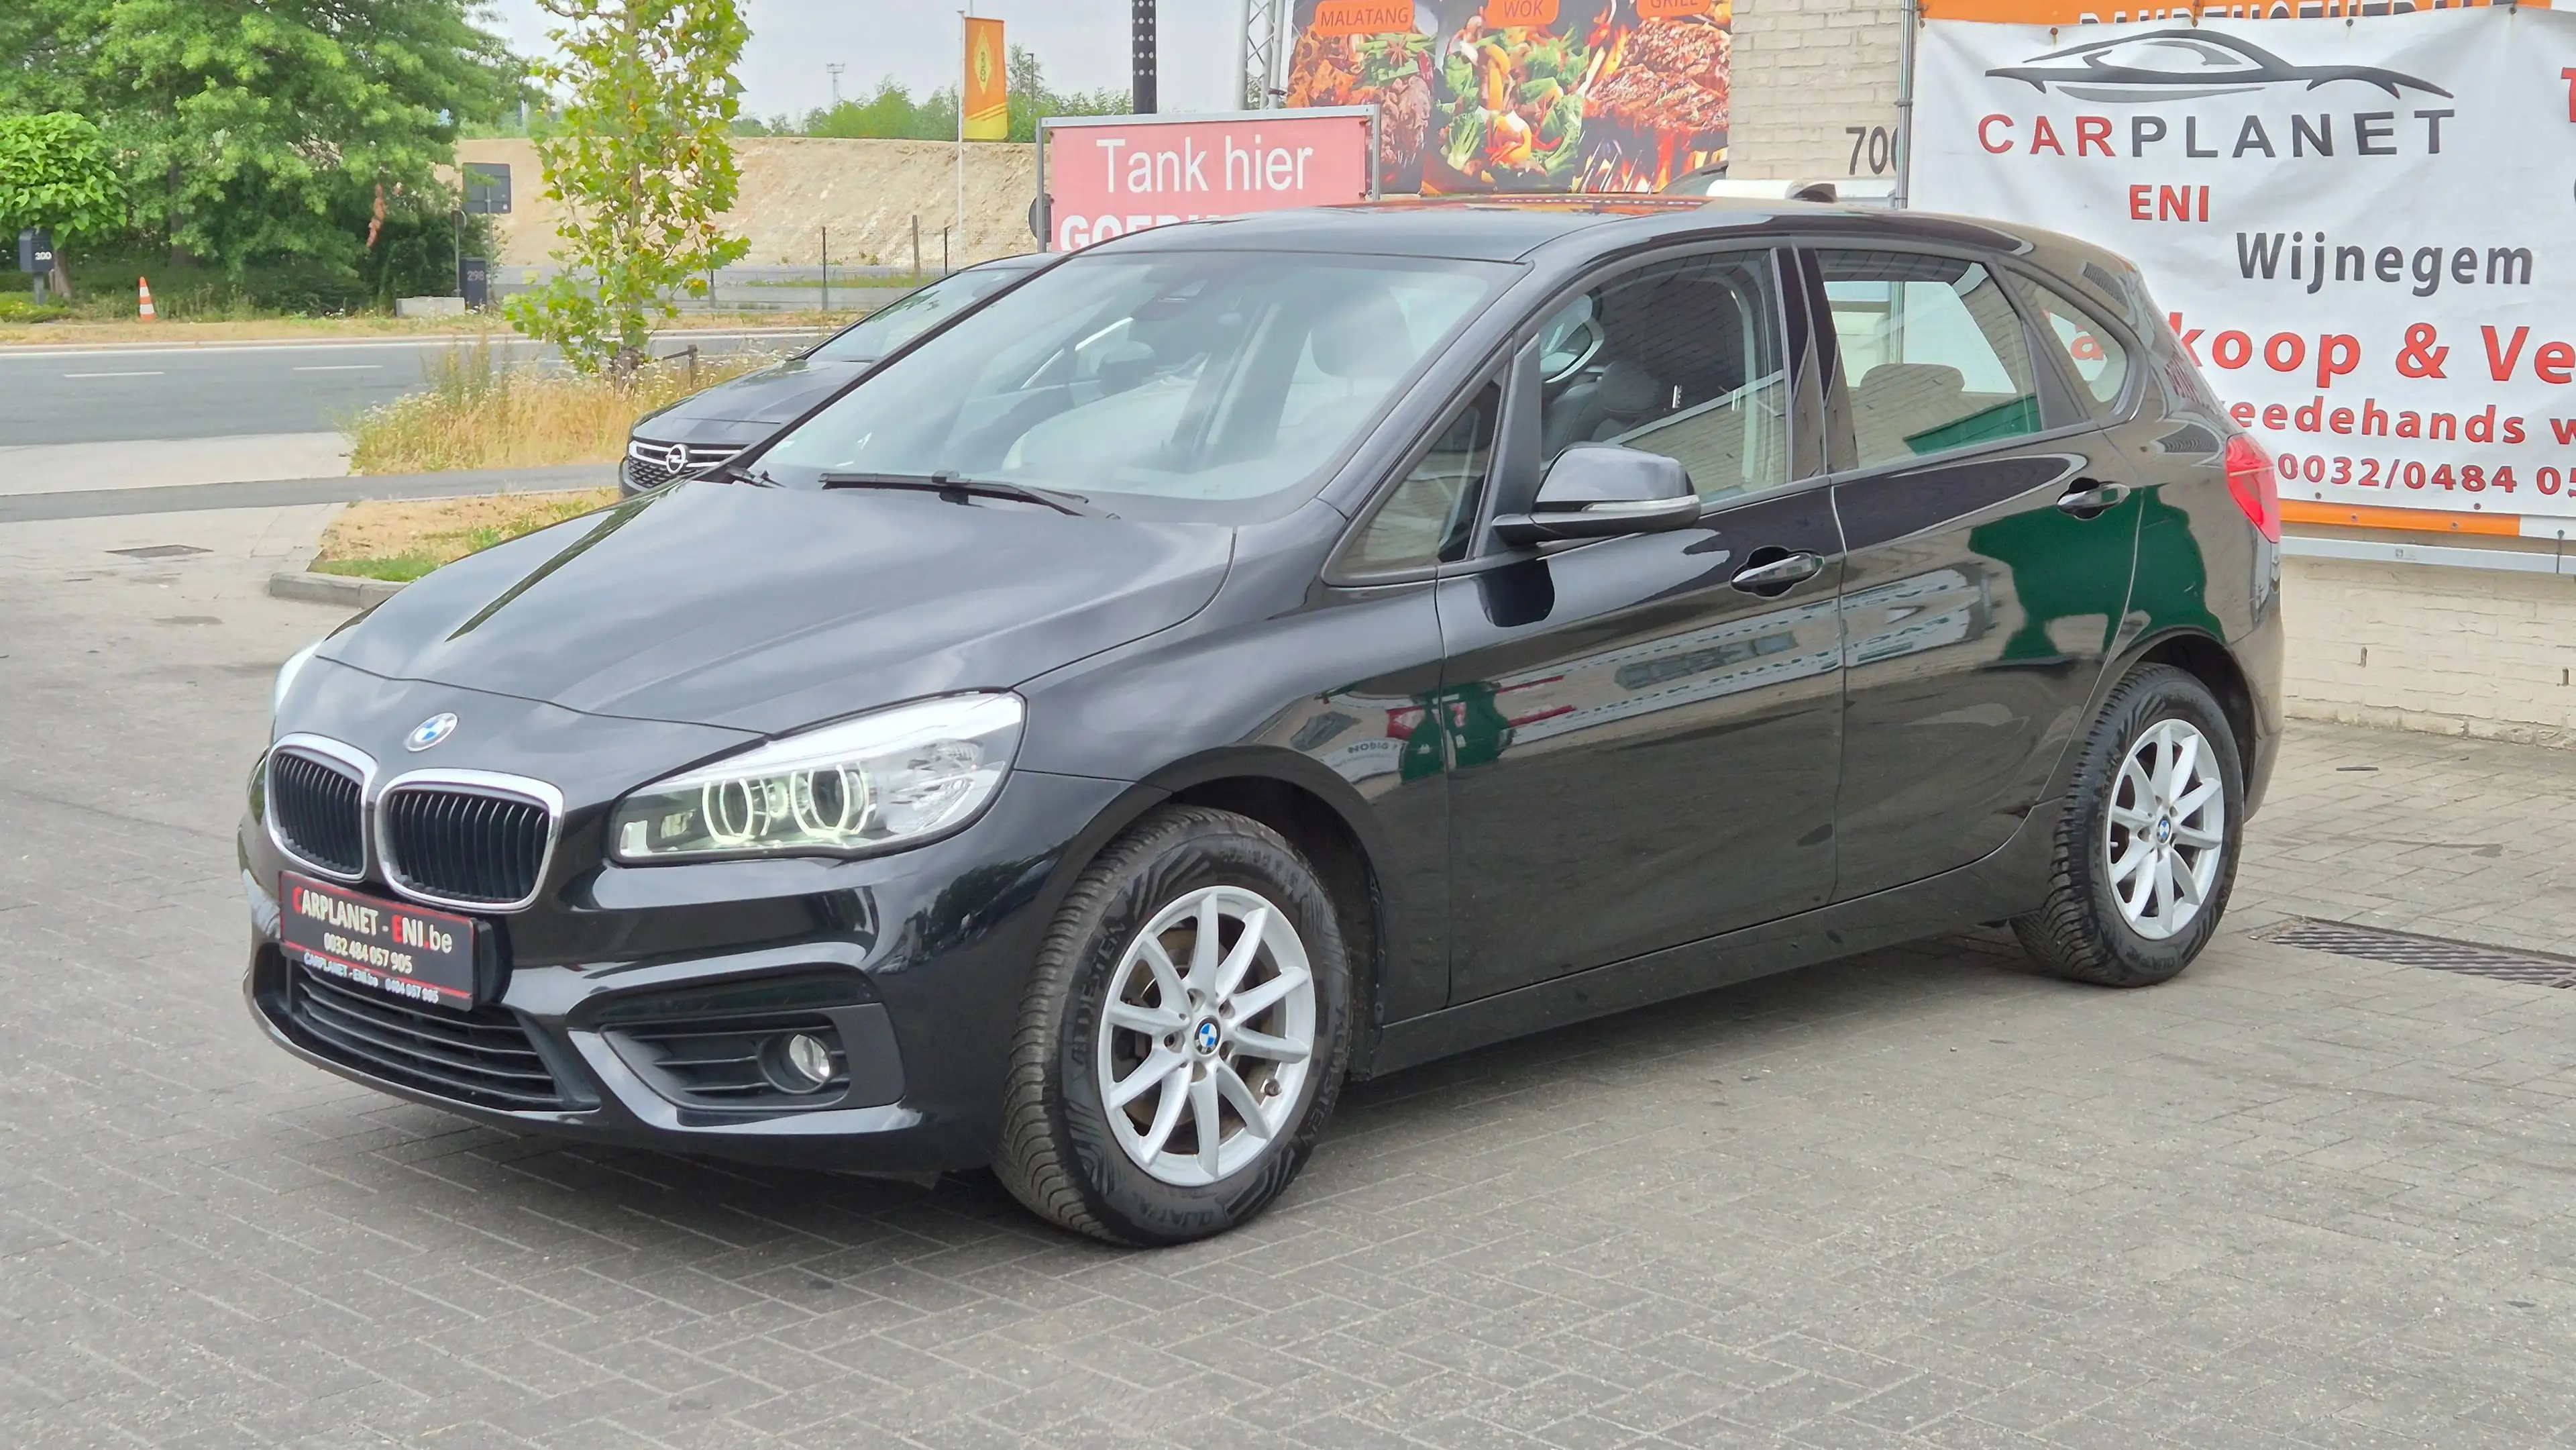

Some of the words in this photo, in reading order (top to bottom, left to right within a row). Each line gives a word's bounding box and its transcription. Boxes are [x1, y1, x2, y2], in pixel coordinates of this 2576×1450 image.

[1320, 6, 1409, 28] MALATANG
[1503, 0, 1543, 17] WOK
[1845, 126, 1900, 175] 70
[1978, 109, 2455, 158] CARPLANET
[1096, 136, 1209, 193] Tank
[1224, 134, 1313, 191] hier
[2129, 185, 2210, 222] ENI
[2235, 231, 2533, 297] Wijnegem
[2395, 322, 2450, 379] &
[2480, 325, 2576, 384] Ve
[2229, 395, 2526, 444] eedehands
[2277, 453, 2518, 493] 0032/0484
[292, 886, 378, 937] CARPLANET
[392, 913, 453, 953] ENI.be
[323, 932, 348, 956] 0032
[349, 940, 369, 962] 484
[369, 945, 389, 968] 057
[390, 951, 413, 974] 905
